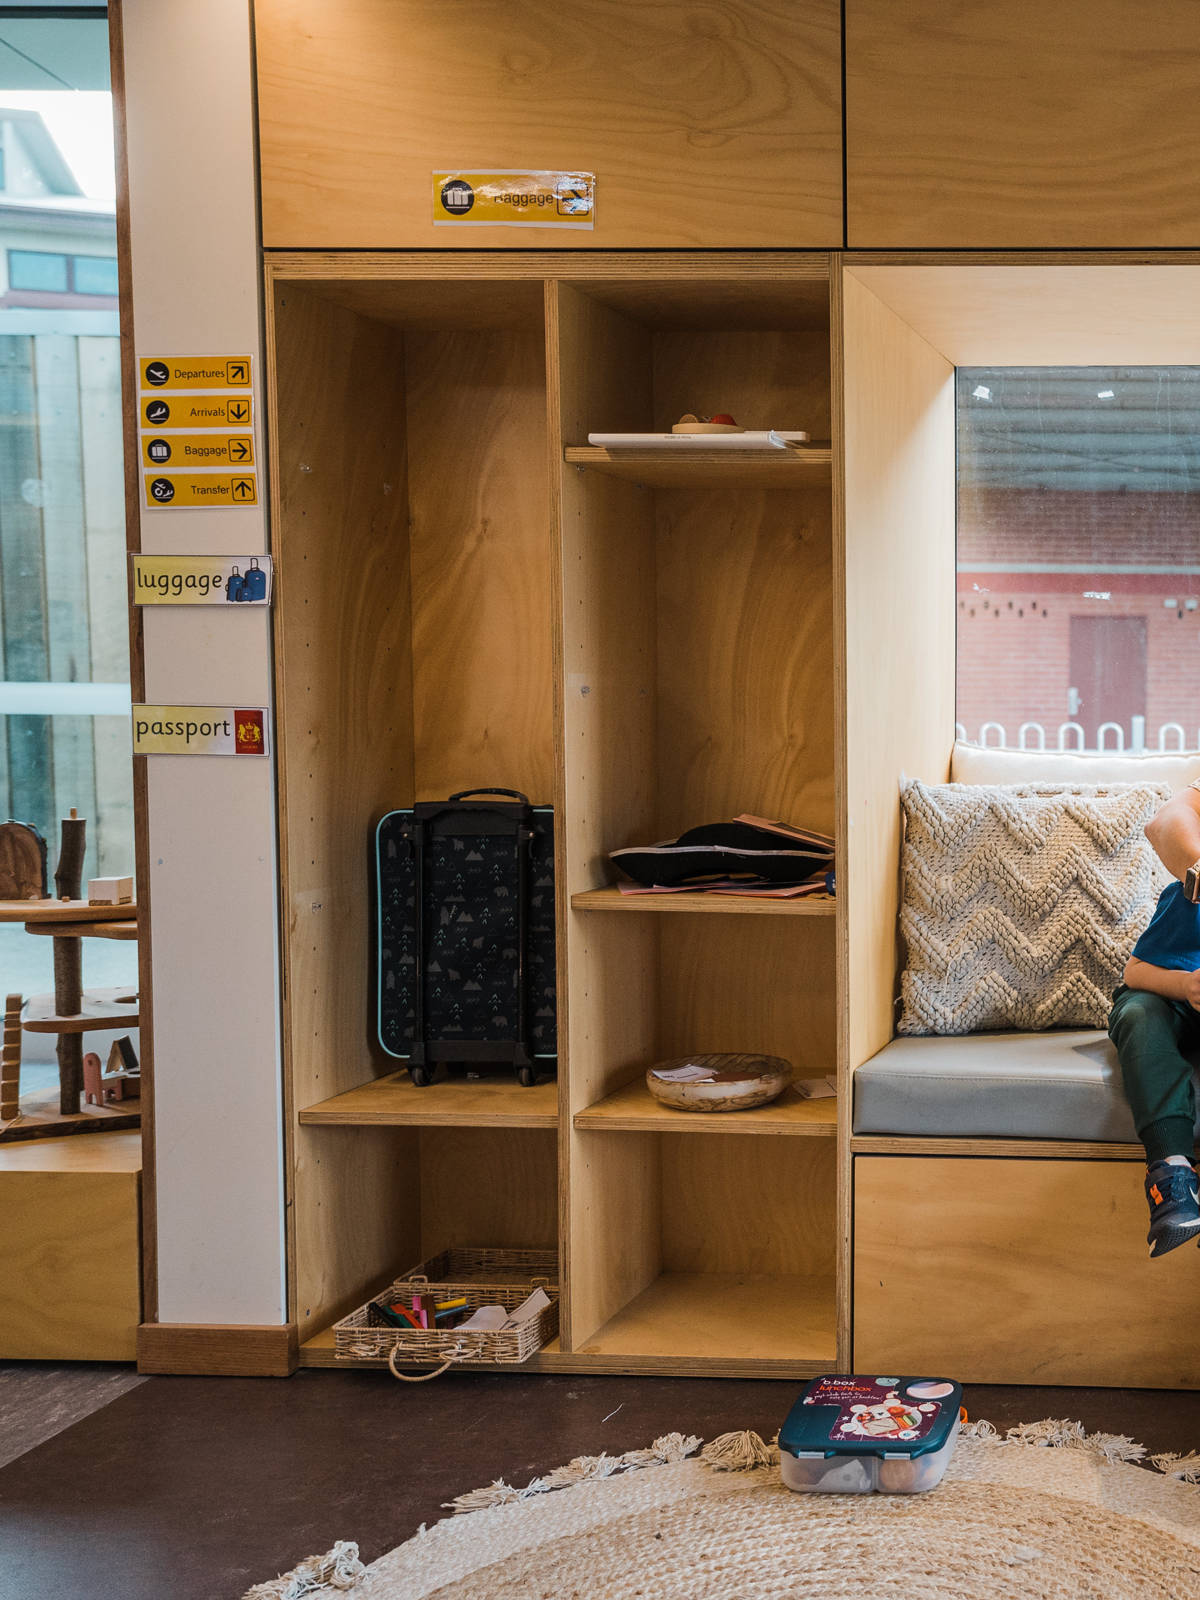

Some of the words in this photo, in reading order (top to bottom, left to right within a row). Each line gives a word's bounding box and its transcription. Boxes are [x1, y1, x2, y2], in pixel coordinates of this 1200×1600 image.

[174, 368, 225, 380] Departures
[190, 407, 226, 417] Arrivals
[184, 445, 228, 457] Baggage
[190, 485, 230, 495] Transfer
[137, 567, 222, 596] luggage
[136, 720, 230, 744] passport
